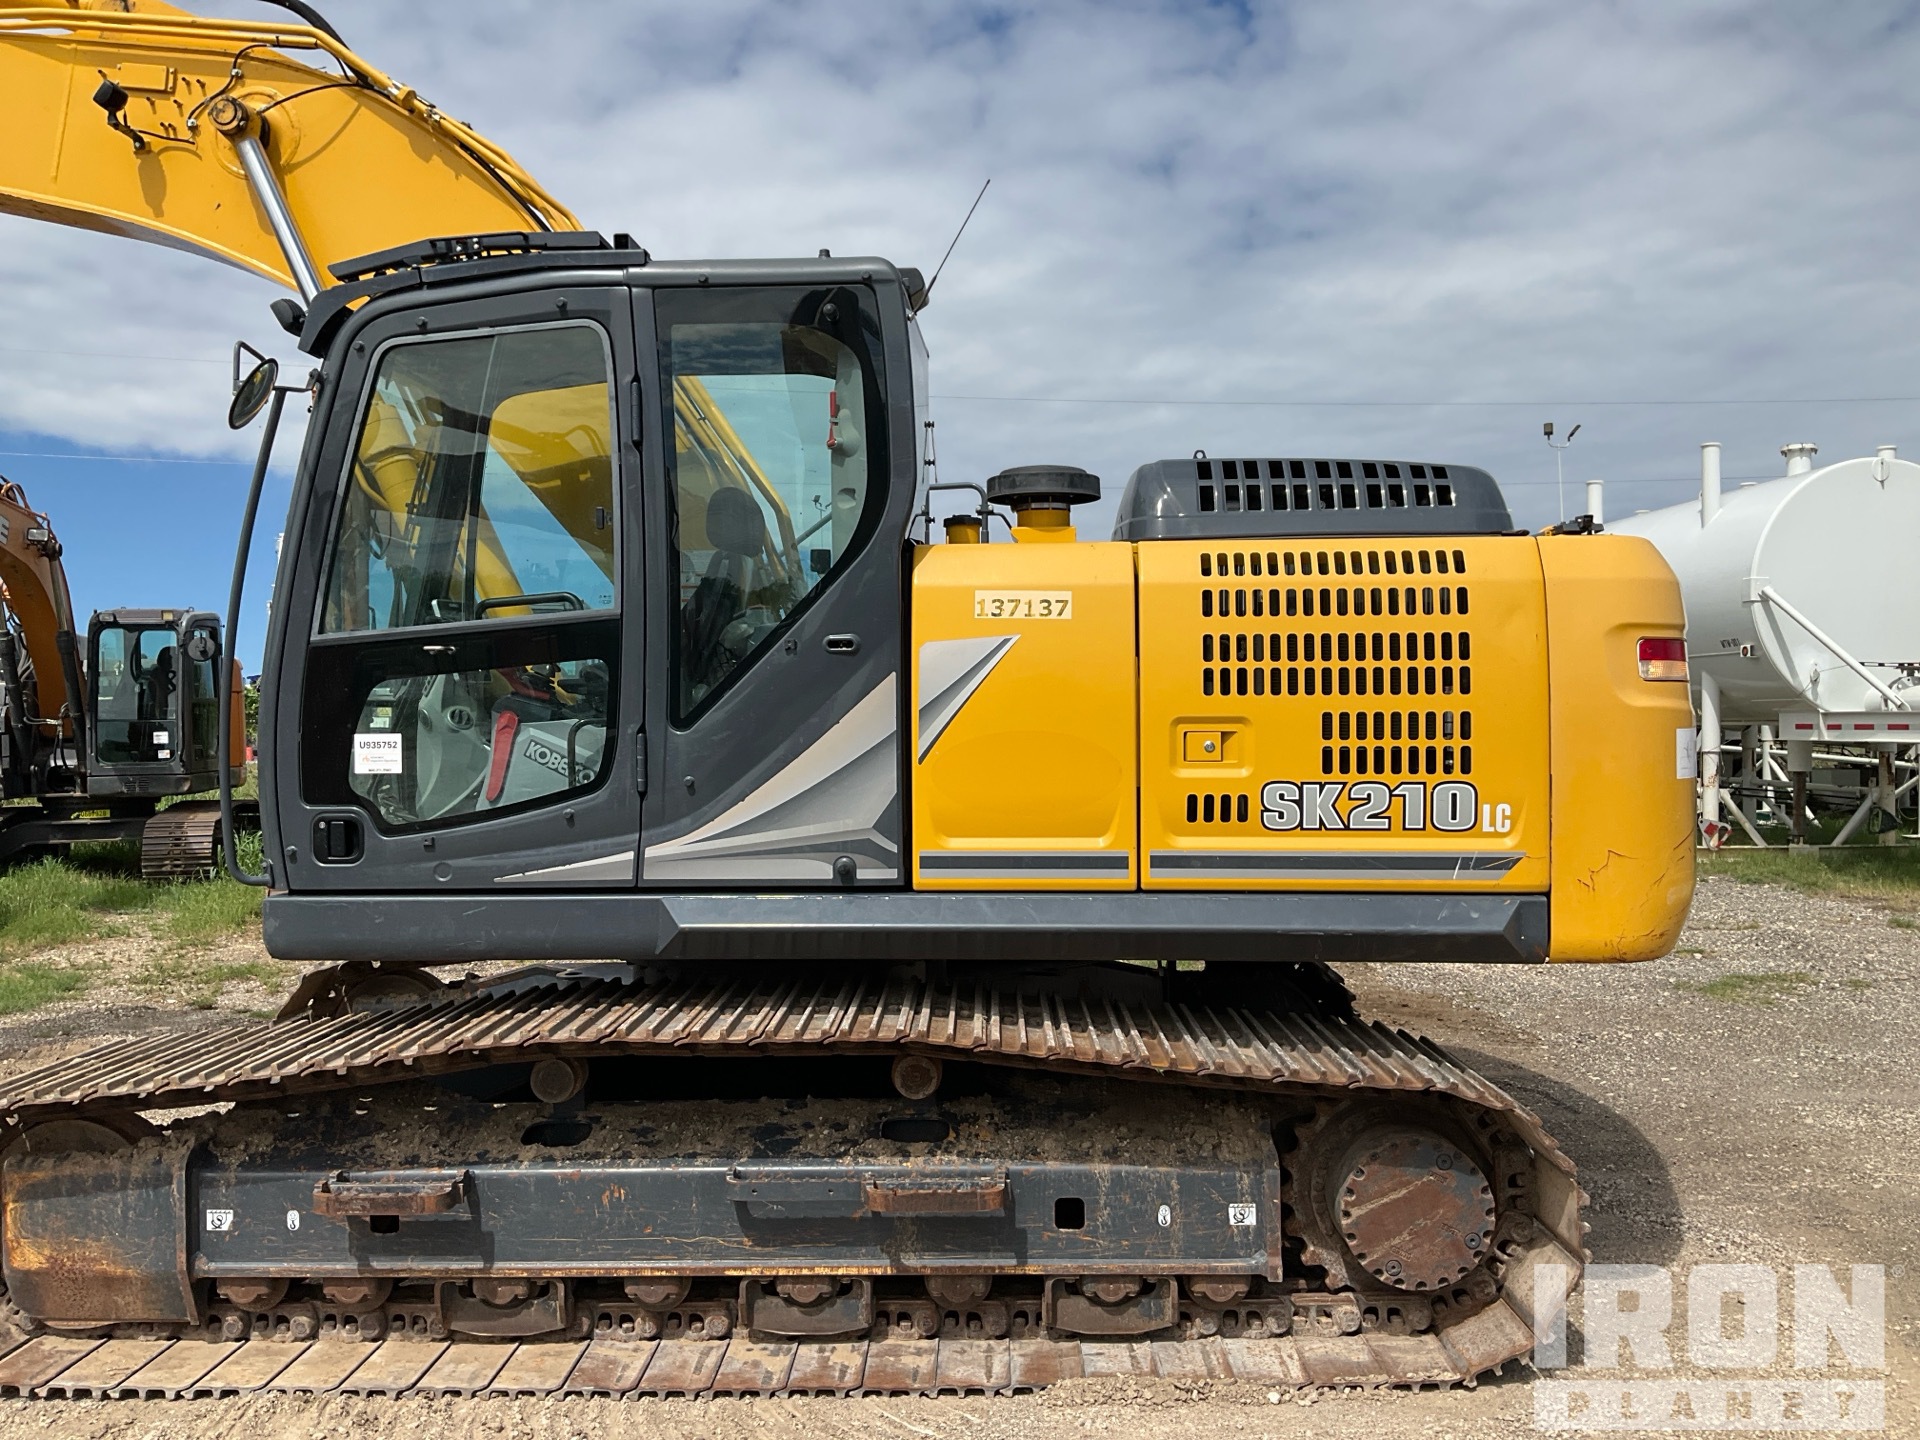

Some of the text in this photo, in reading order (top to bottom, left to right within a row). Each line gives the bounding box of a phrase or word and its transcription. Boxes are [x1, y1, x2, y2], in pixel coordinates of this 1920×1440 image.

[976, 598, 1069, 617] 137137
[359, 741, 398, 749] U935752
[1261, 780, 1511, 833] SK210 LC
